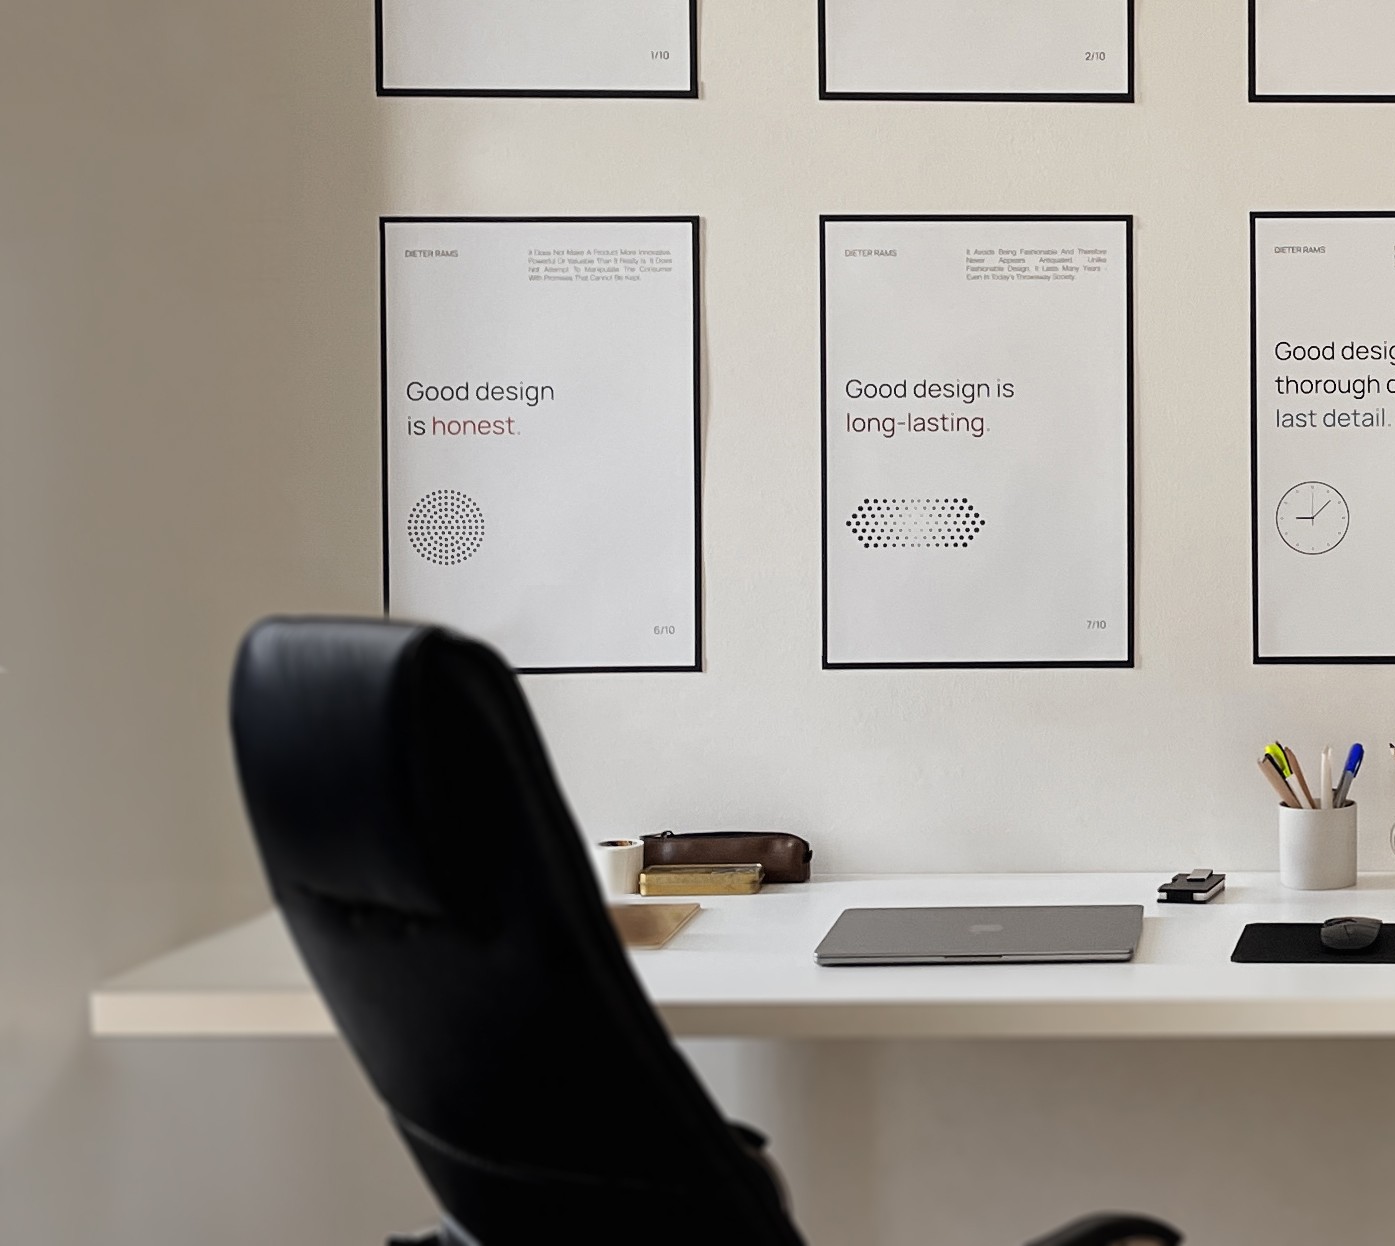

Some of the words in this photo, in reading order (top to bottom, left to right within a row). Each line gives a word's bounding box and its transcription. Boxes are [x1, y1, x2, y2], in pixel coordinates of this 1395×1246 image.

[650, 50, 670, 61] 1/10
[1084, 51, 1106, 62] 2/10
[404, 249, 434, 258] DIETER
[434, 249, 459, 258] RAMS
[844, 248, 873, 258] DIETER
[873, 248, 898, 258] RAMS
[1273, 245, 1302, 254] DIETER
[1302, 245, 1327, 254] RAMS
[1274, 340, 1335, 361] Good
[406, 381, 469, 402] Good
[475, 380, 555, 408] design
[845, 378, 907, 399] Good
[913, 378, 991, 405] design
[996, 378, 1015, 399] is
[1274, 374, 1381, 400] thorough
[407, 415, 426, 436] is
[432, 415, 521, 436] honest.
[846, 412, 991, 439] long-lasting.
[1276, 408, 1318, 429] last
[1322, 407, 1392, 428] detail.
[653, 625, 676, 635] 6/10
[1086, 619, 1107, 630] 7/10
